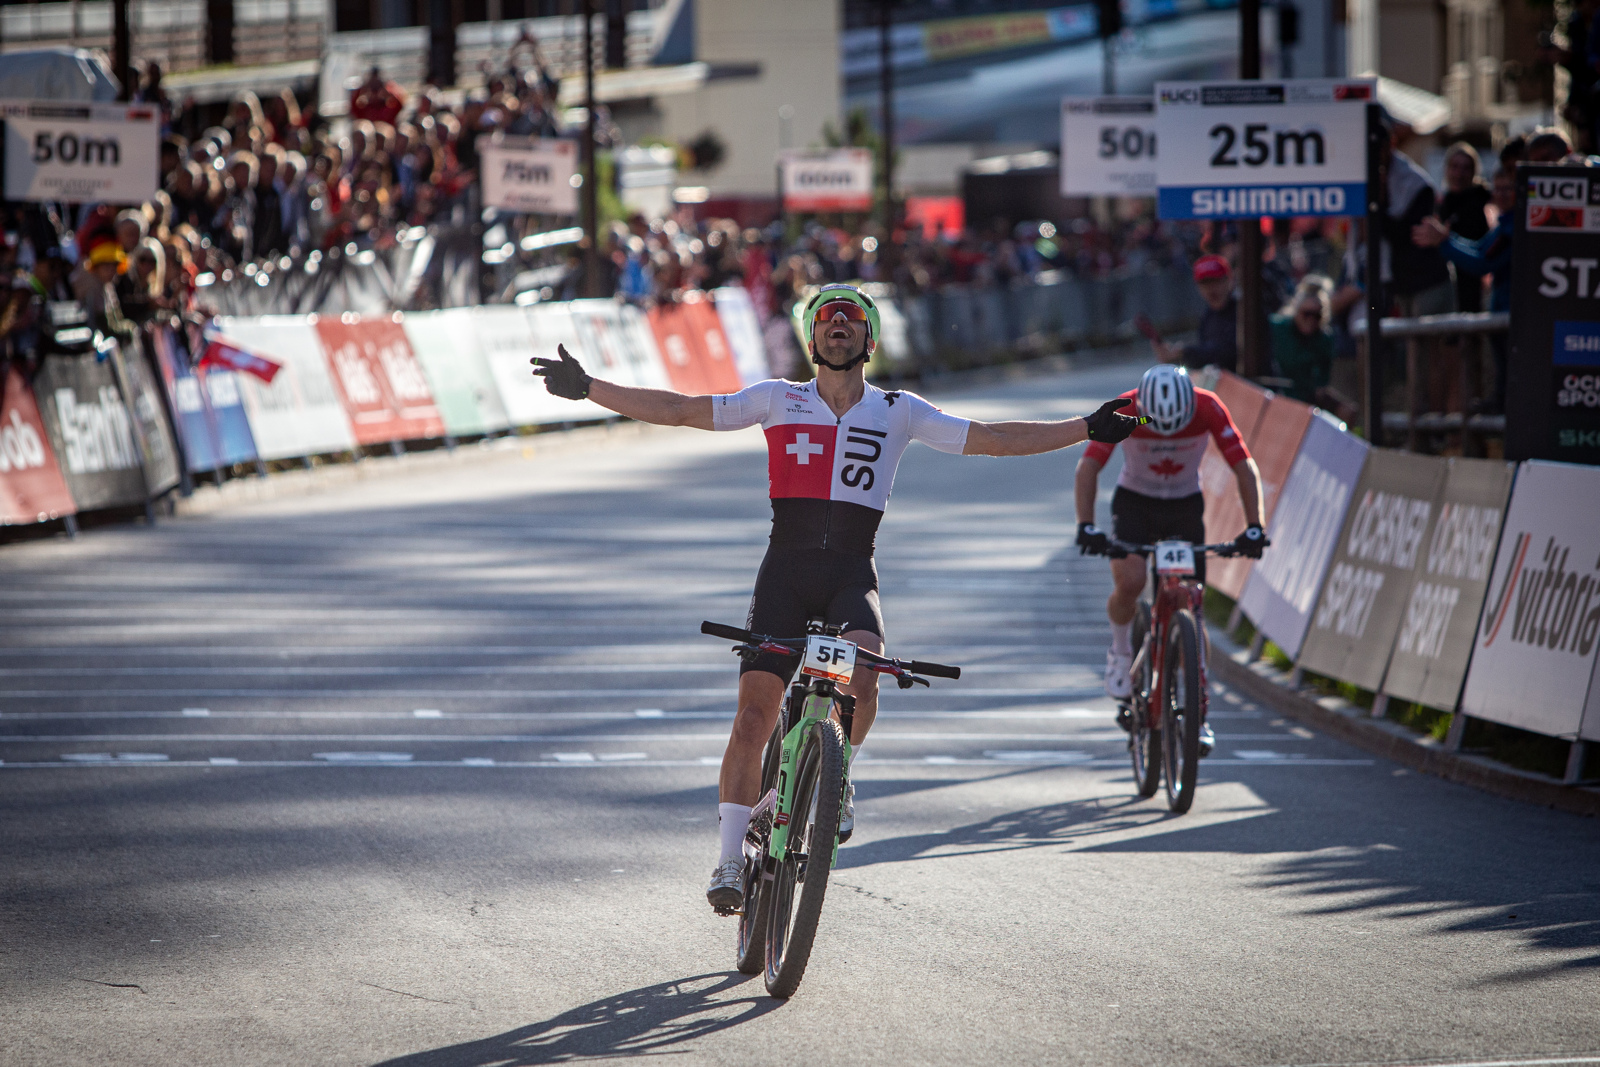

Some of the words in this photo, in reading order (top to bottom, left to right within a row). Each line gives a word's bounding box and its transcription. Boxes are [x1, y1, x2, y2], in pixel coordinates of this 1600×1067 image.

[33, 130, 121, 165] 50m
[1209, 124, 1326, 167] 25m
[1191, 187, 1346, 216] SHIMANO
[1539, 182, 1583, 199] UCI
[1538, 256, 1600, 298] ST
[840, 426, 887, 491] SUI
[1163, 550, 1185, 563] 4F
[1317, 561, 1385, 640] SPORT
[1399, 580, 1460, 660] SPORT
[816, 645, 846, 665] 5F
